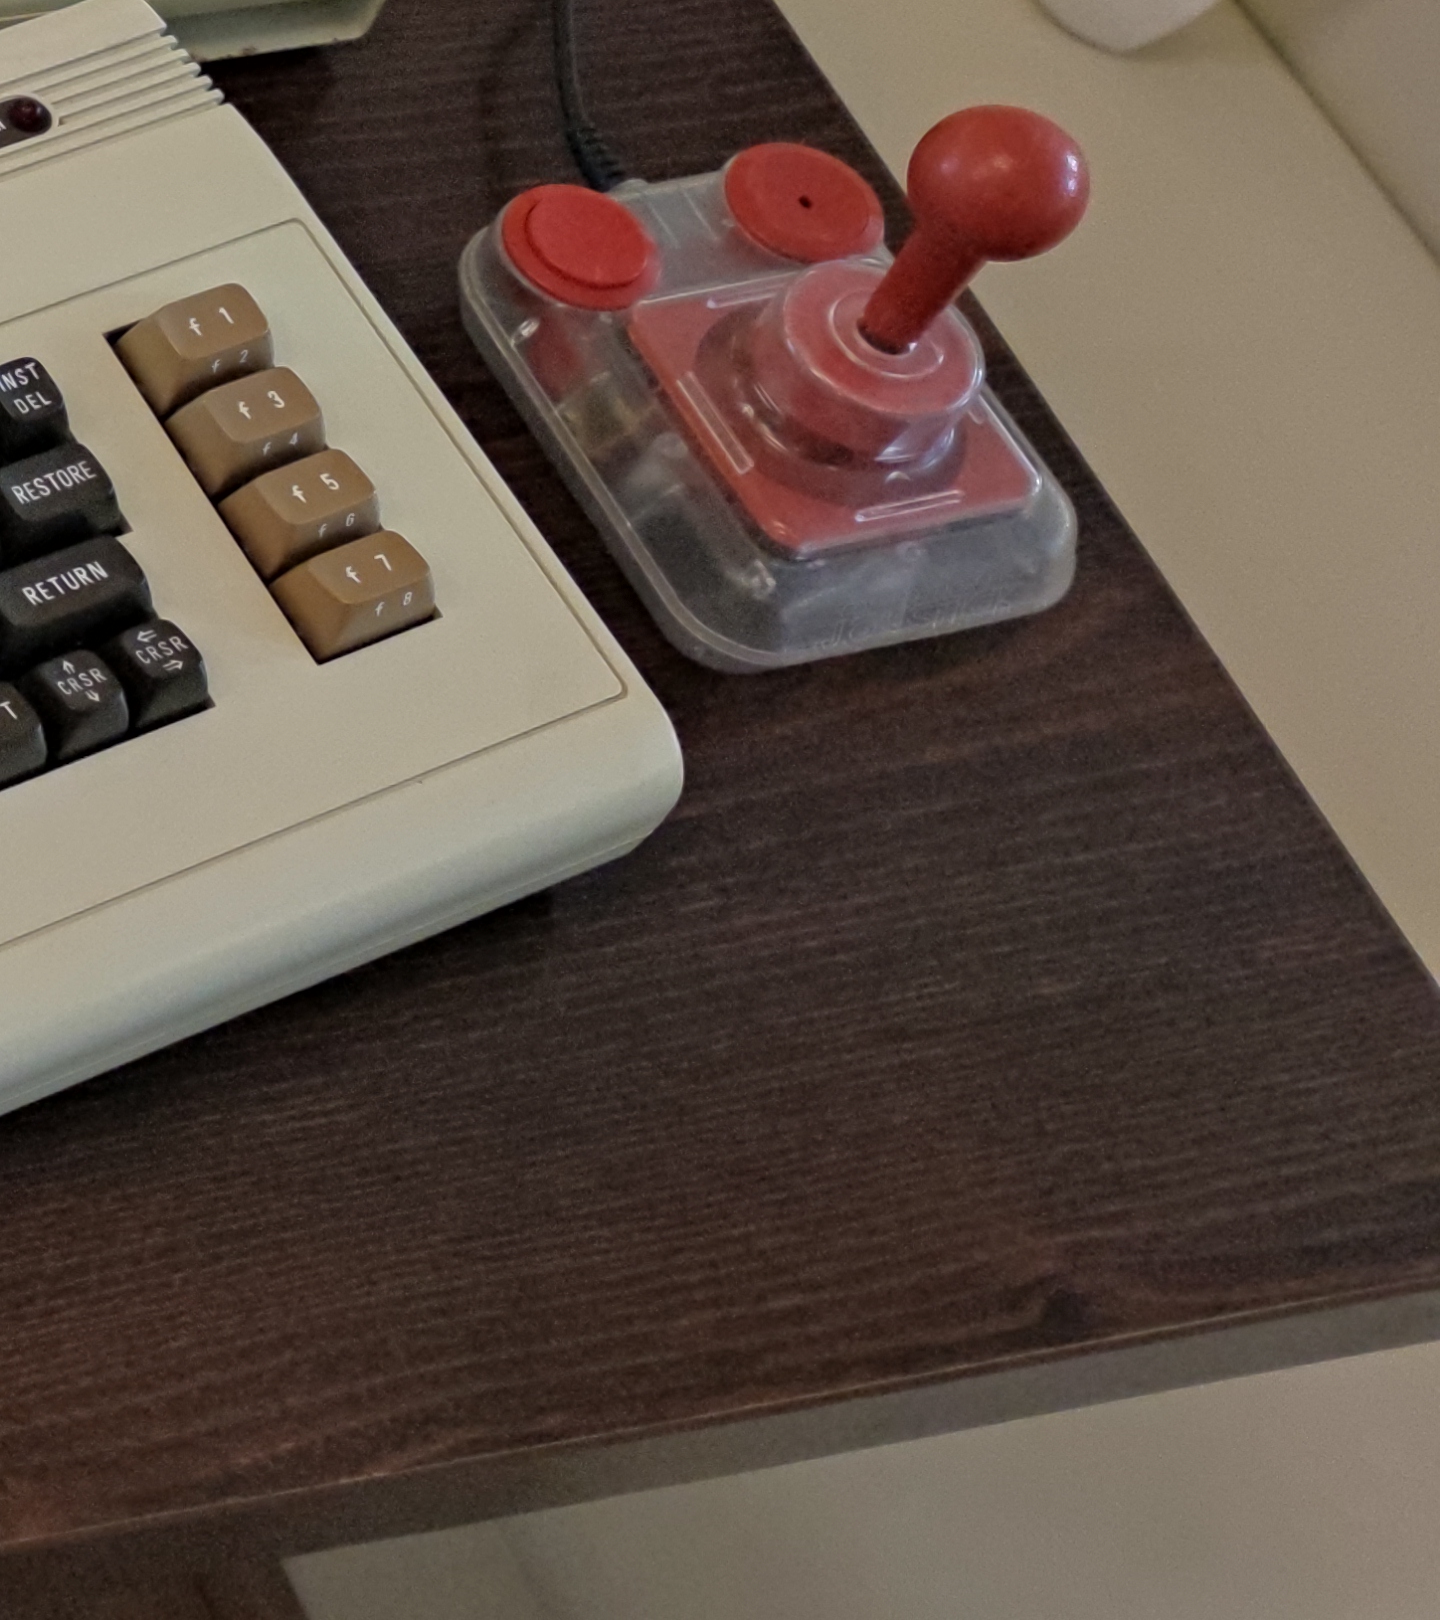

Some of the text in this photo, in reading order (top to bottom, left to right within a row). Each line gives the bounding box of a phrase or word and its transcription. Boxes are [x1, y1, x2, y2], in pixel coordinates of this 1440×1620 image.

[11, 389, 52, 415] DEL
[10, 459, 97, 507] RESTORE
[21, 561, 110, 607] RETURN
[134, 635, 189, 665] CRSR
[55, 666, 108, 697] CRSR
